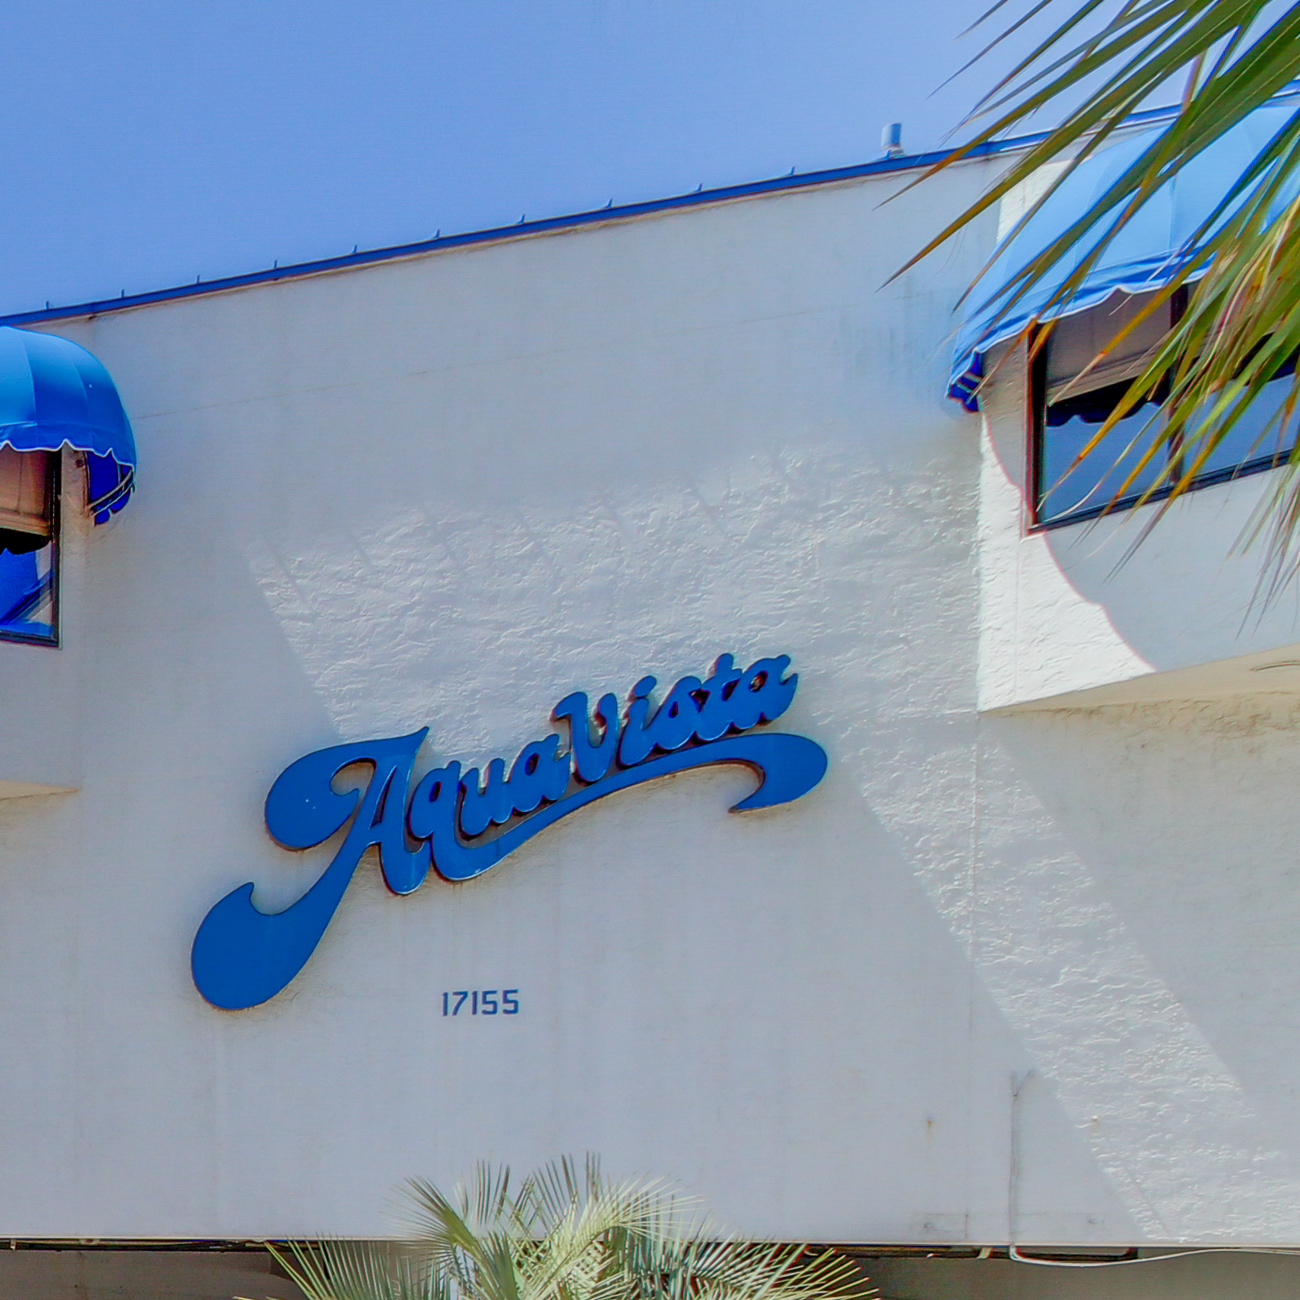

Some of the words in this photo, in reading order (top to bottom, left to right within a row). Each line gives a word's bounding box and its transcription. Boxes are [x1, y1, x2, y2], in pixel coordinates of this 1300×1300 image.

[191, 725, 572, 1011] Aqua
[551, 652, 799, 783] Vista
[441, 988, 519, 1017] 17155
